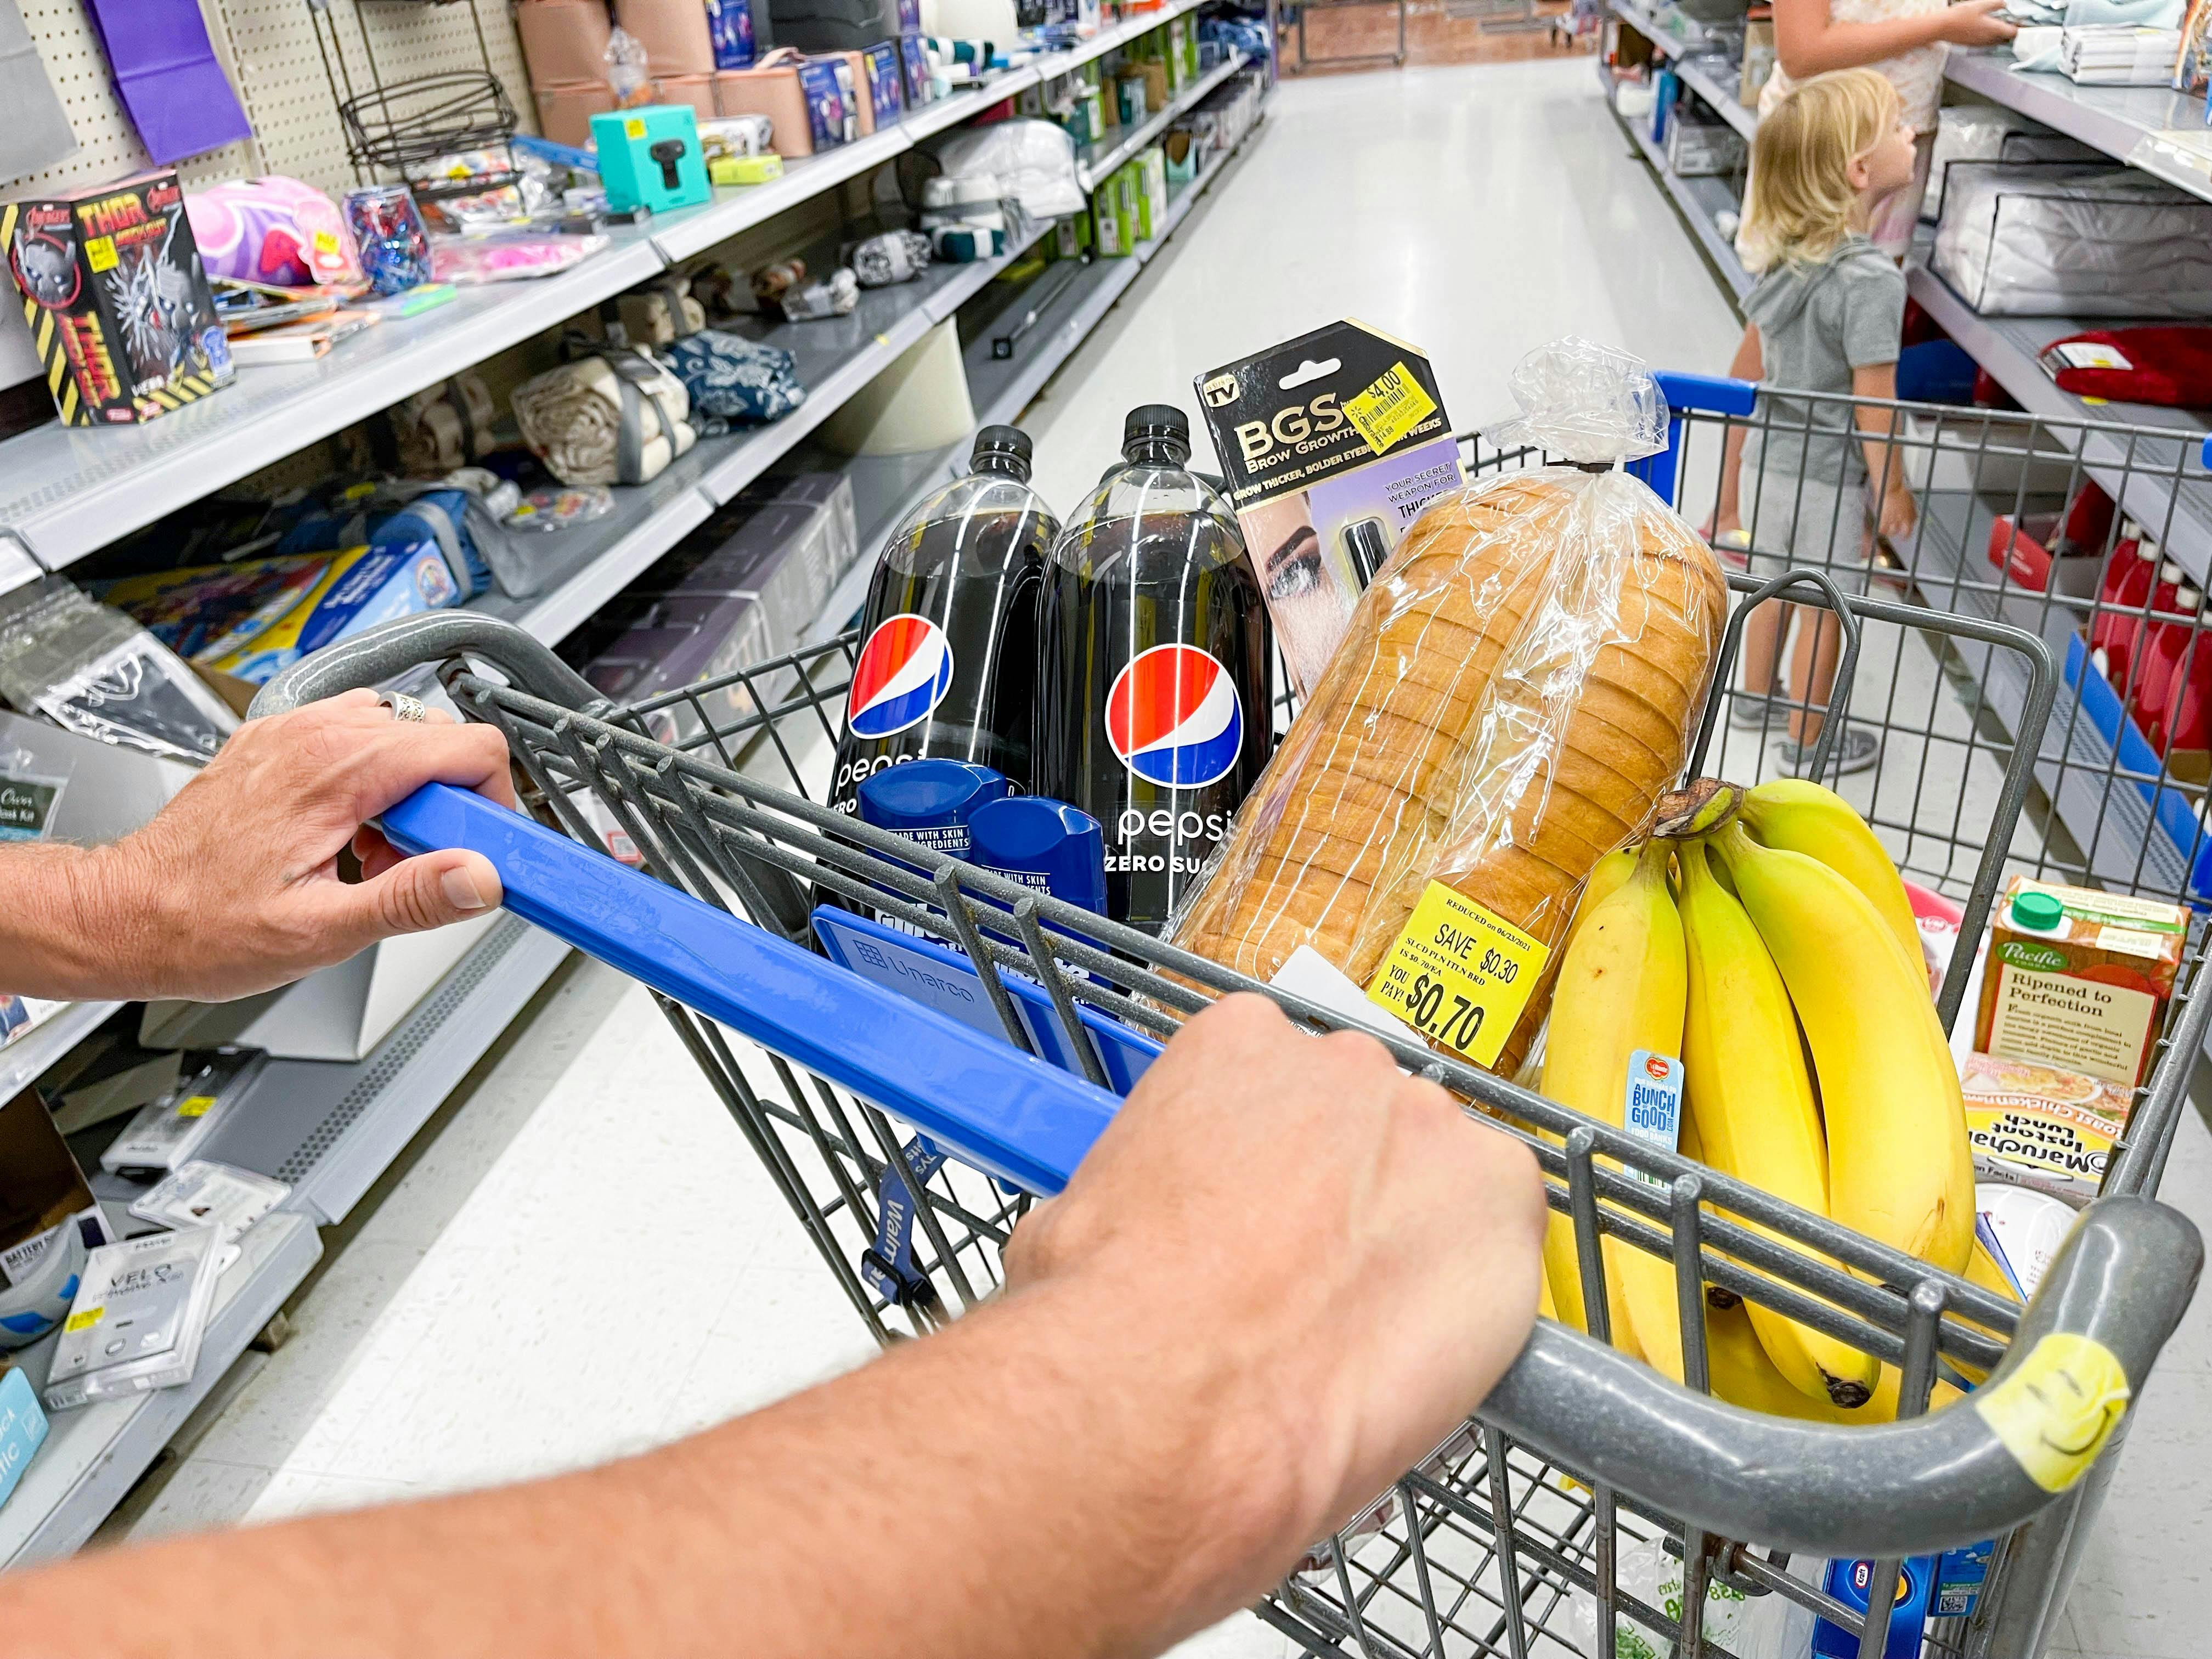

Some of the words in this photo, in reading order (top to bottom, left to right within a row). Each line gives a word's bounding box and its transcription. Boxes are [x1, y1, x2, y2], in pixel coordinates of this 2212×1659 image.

[77, 193, 148, 238] THOR
[74, 311, 121, 402] THOR
[1207, 382, 1234, 404] TV
[1367, 370, 1401, 399] $4.00
[1234, 392, 1344, 461] BGS
[1359, 416, 1384, 448] Clearance
[1233, 483, 1262, 500] GROW
[1262, 469, 1305, 491] THICKER,
[1305, 454, 1343, 475] BOLDER
[1409, 417, 1442, 437] WEEKS
[1385, 477, 1412, 492] YOUR
[1414, 462, 1451, 482] SECRET
[1389, 482, 1432, 503] WEAPON
[1434, 474, 1455, 487] FOR
[832, 799, 857, 814] ERO
[915, 839, 969, 849] GREDIENTS
[916, 831, 939, 840] WITH
[942, 829, 963, 839] SKIN
[1104, 855, 1165, 872] ZERO
[1026, 876, 1046, 885] SKIN
[1446, 899, 1486, 925] REDUCED
[1487, 923, 1496, 932] on
[1497, 928, 1531, 951] 06/23/2021
[1400, 949, 1408, 957] IS
[1406, 938, 1428, 953] SLCD
[1429, 950, 1447, 963] PLN
[1446, 959, 1468, 977] ITLN
[1468, 970, 1485, 986] BRD
[1435, 923, 1477, 960] SAVE
[1480, 947, 1518, 984] $0.30
[2003, 942, 2061, 966] Pacific
[887, 956, 975, 1003] Unarco
[1389, 964, 1410, 984] YOU
[2012, 973, 2087, 999] Ripened
[2094, 989, 2112, 1003] to
[1380, 981, 1404, 1002] PAY!
[2009, 987, 2103, 1017] Perfection
[1406, 973, 1485, 1050] $0.70
[1633, 1087, 1675, 1117] BUNCH
[1632, 1107, 1667, 1131] GOOD
[2005, 1114, 2074, 1138] Lunch
[1991, 1122, 2082, 1152] Instant
[1858, 1568, 1867, 1584] Kraft
